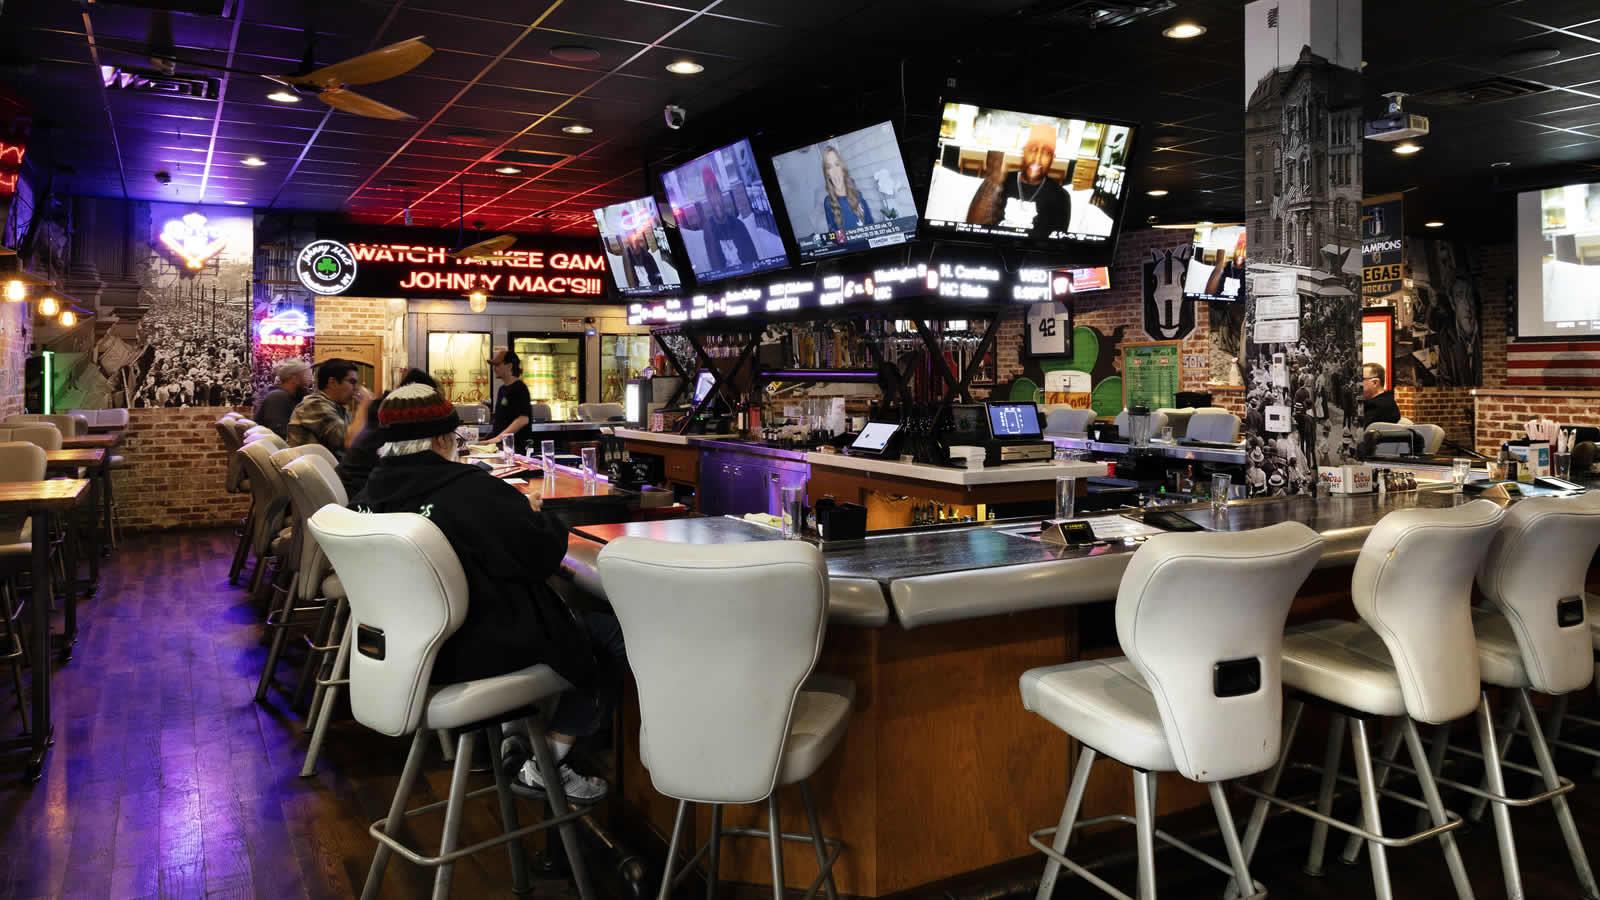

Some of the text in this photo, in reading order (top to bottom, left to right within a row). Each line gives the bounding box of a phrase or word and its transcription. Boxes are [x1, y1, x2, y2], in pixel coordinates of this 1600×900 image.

[348, 243, 605, 271] WATCH ANKEE GAM
[1363, 265, 1401, 281] EGAS
[508, 275, 601, 294] MAC'S!!!
[1039, 318, 1056, 337] 42
